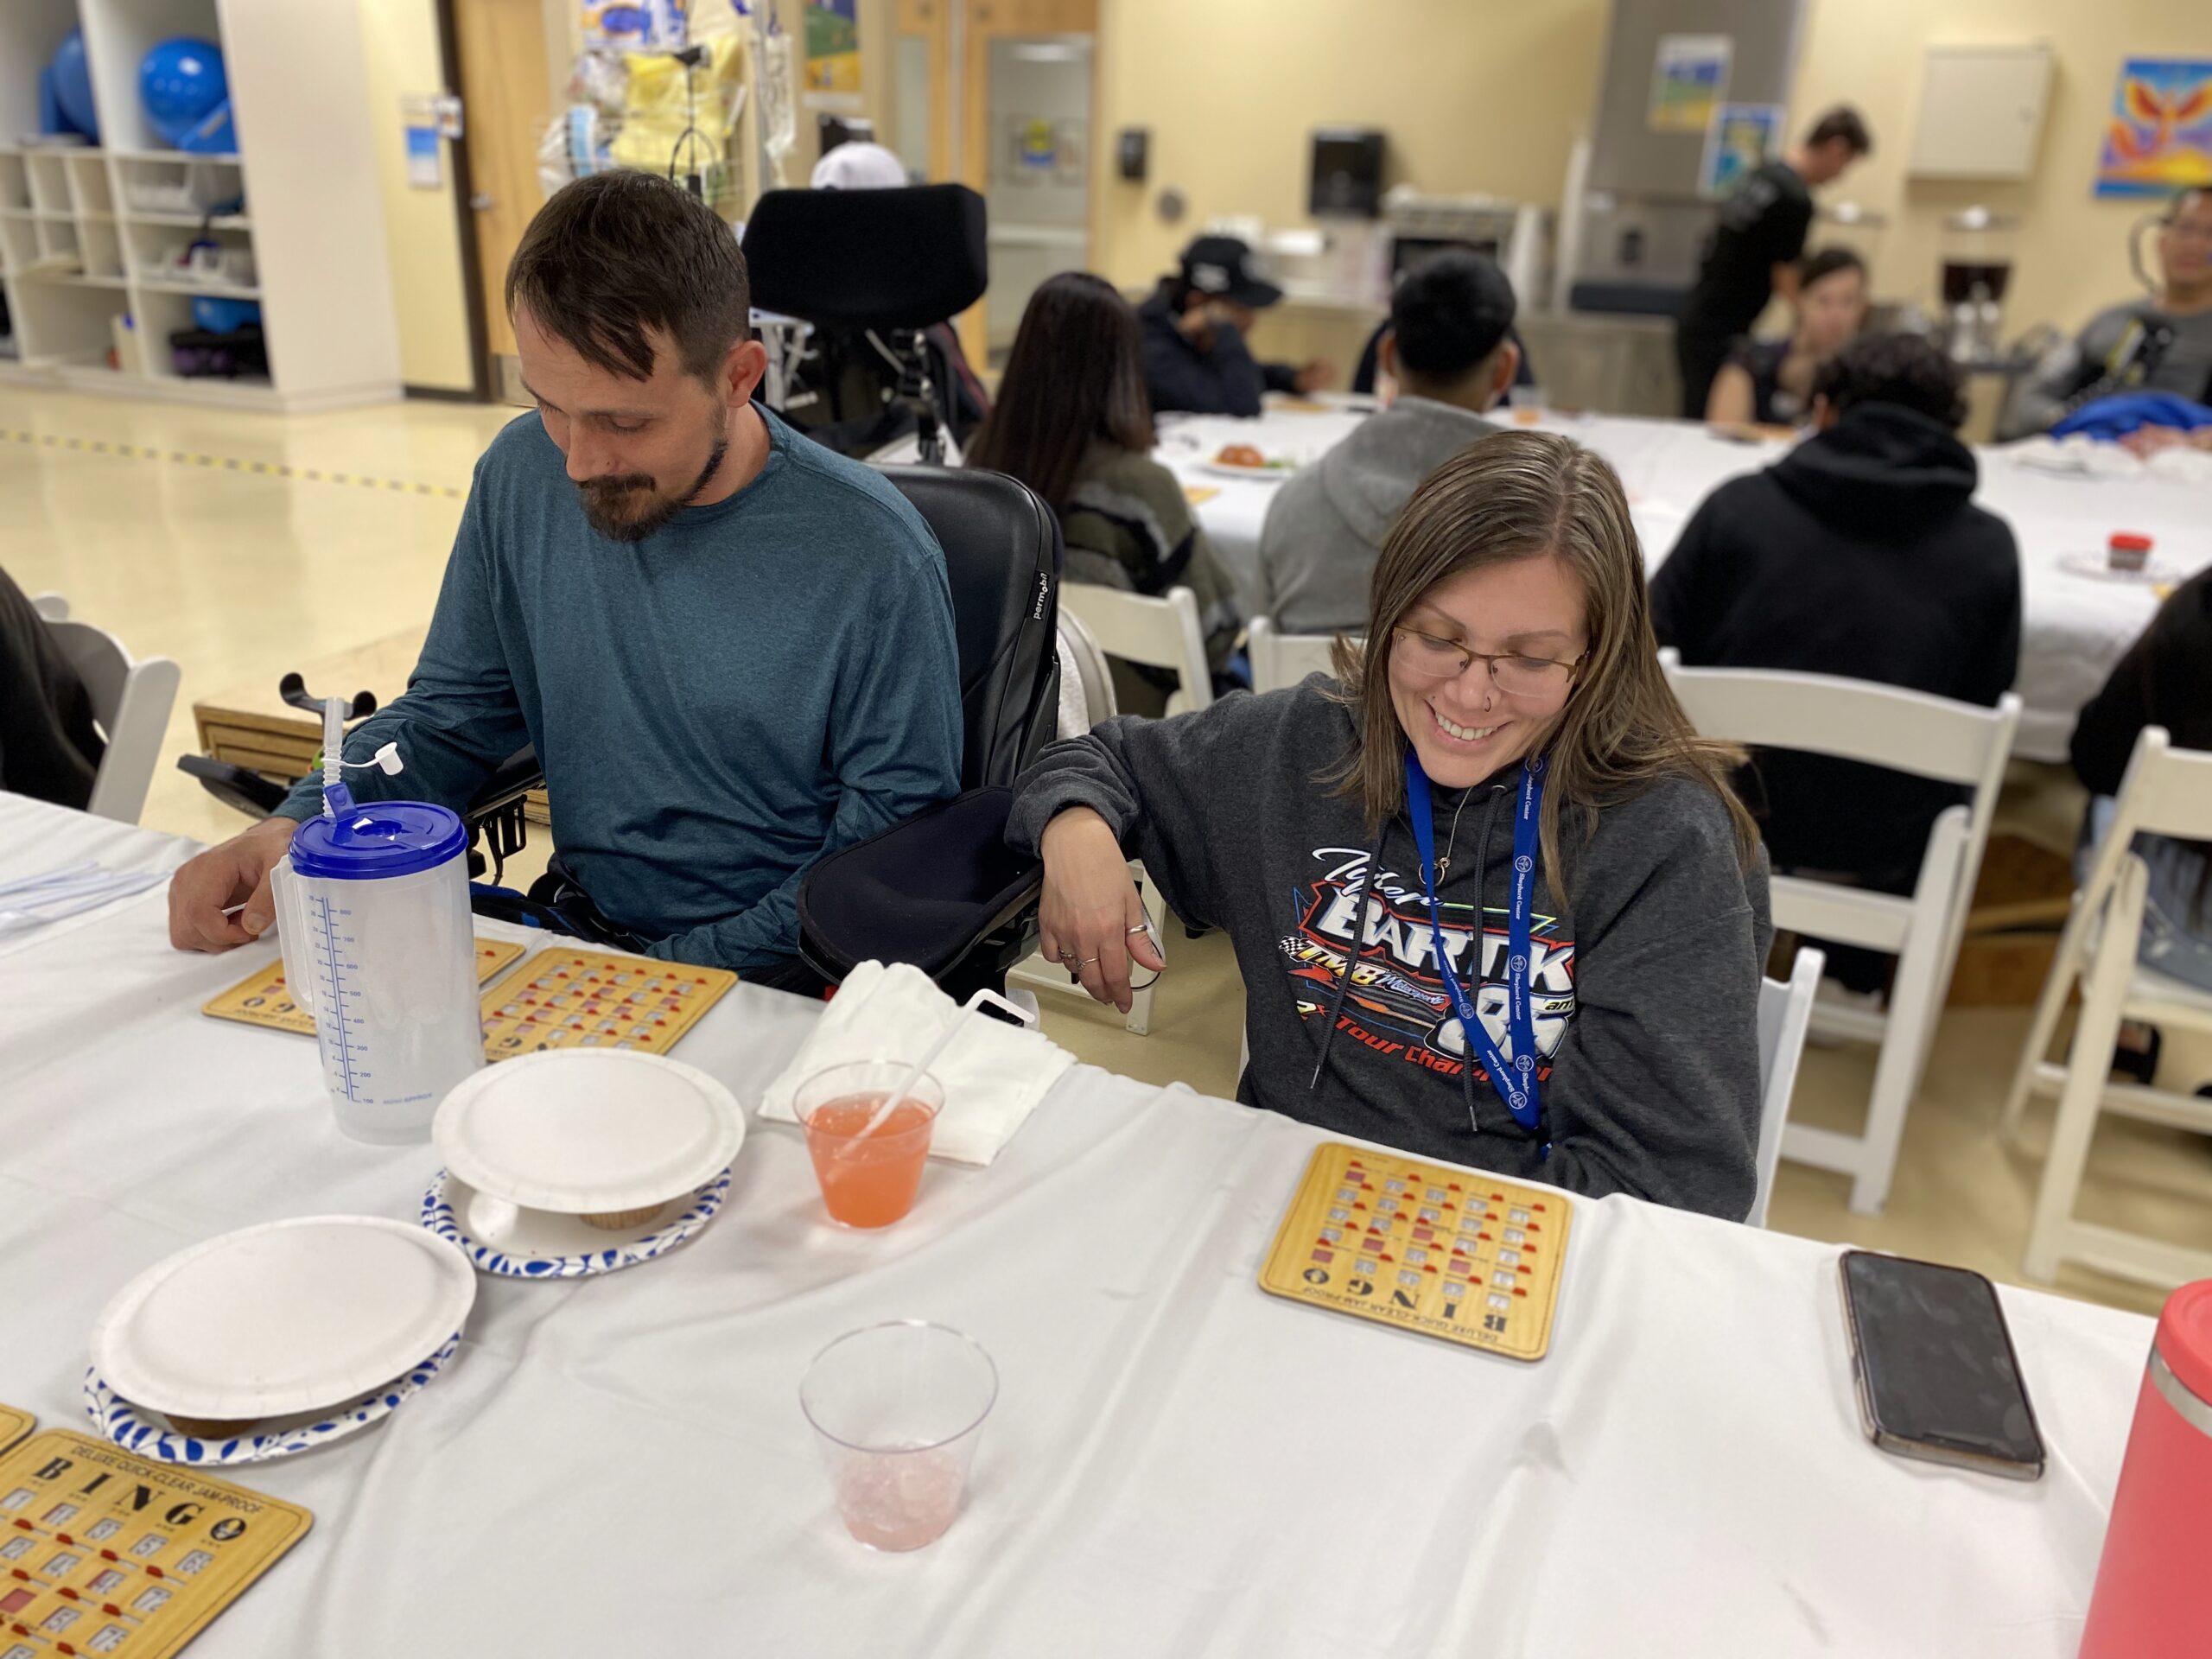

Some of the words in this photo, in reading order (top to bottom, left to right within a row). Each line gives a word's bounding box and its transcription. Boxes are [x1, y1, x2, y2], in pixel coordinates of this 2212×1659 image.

[1033, 573, 1048, 620] permobil
[1523, 800, 1532, 820] Center
[1517, 873, 1526, 899] Shepherd
[1315, 886, 1574, 992] BARTK
[1336, 1015, 1405, 1054] Tour
[1487, 1050, 1501, 1068] Center
[1496, 1065, 1515, 1093] Shepherd
[1302, 1268, 1508, 1333] BINGO
[70, 1445, 117, 1467] DELUXE
[32, 1457, 247, 1541] BINGO
